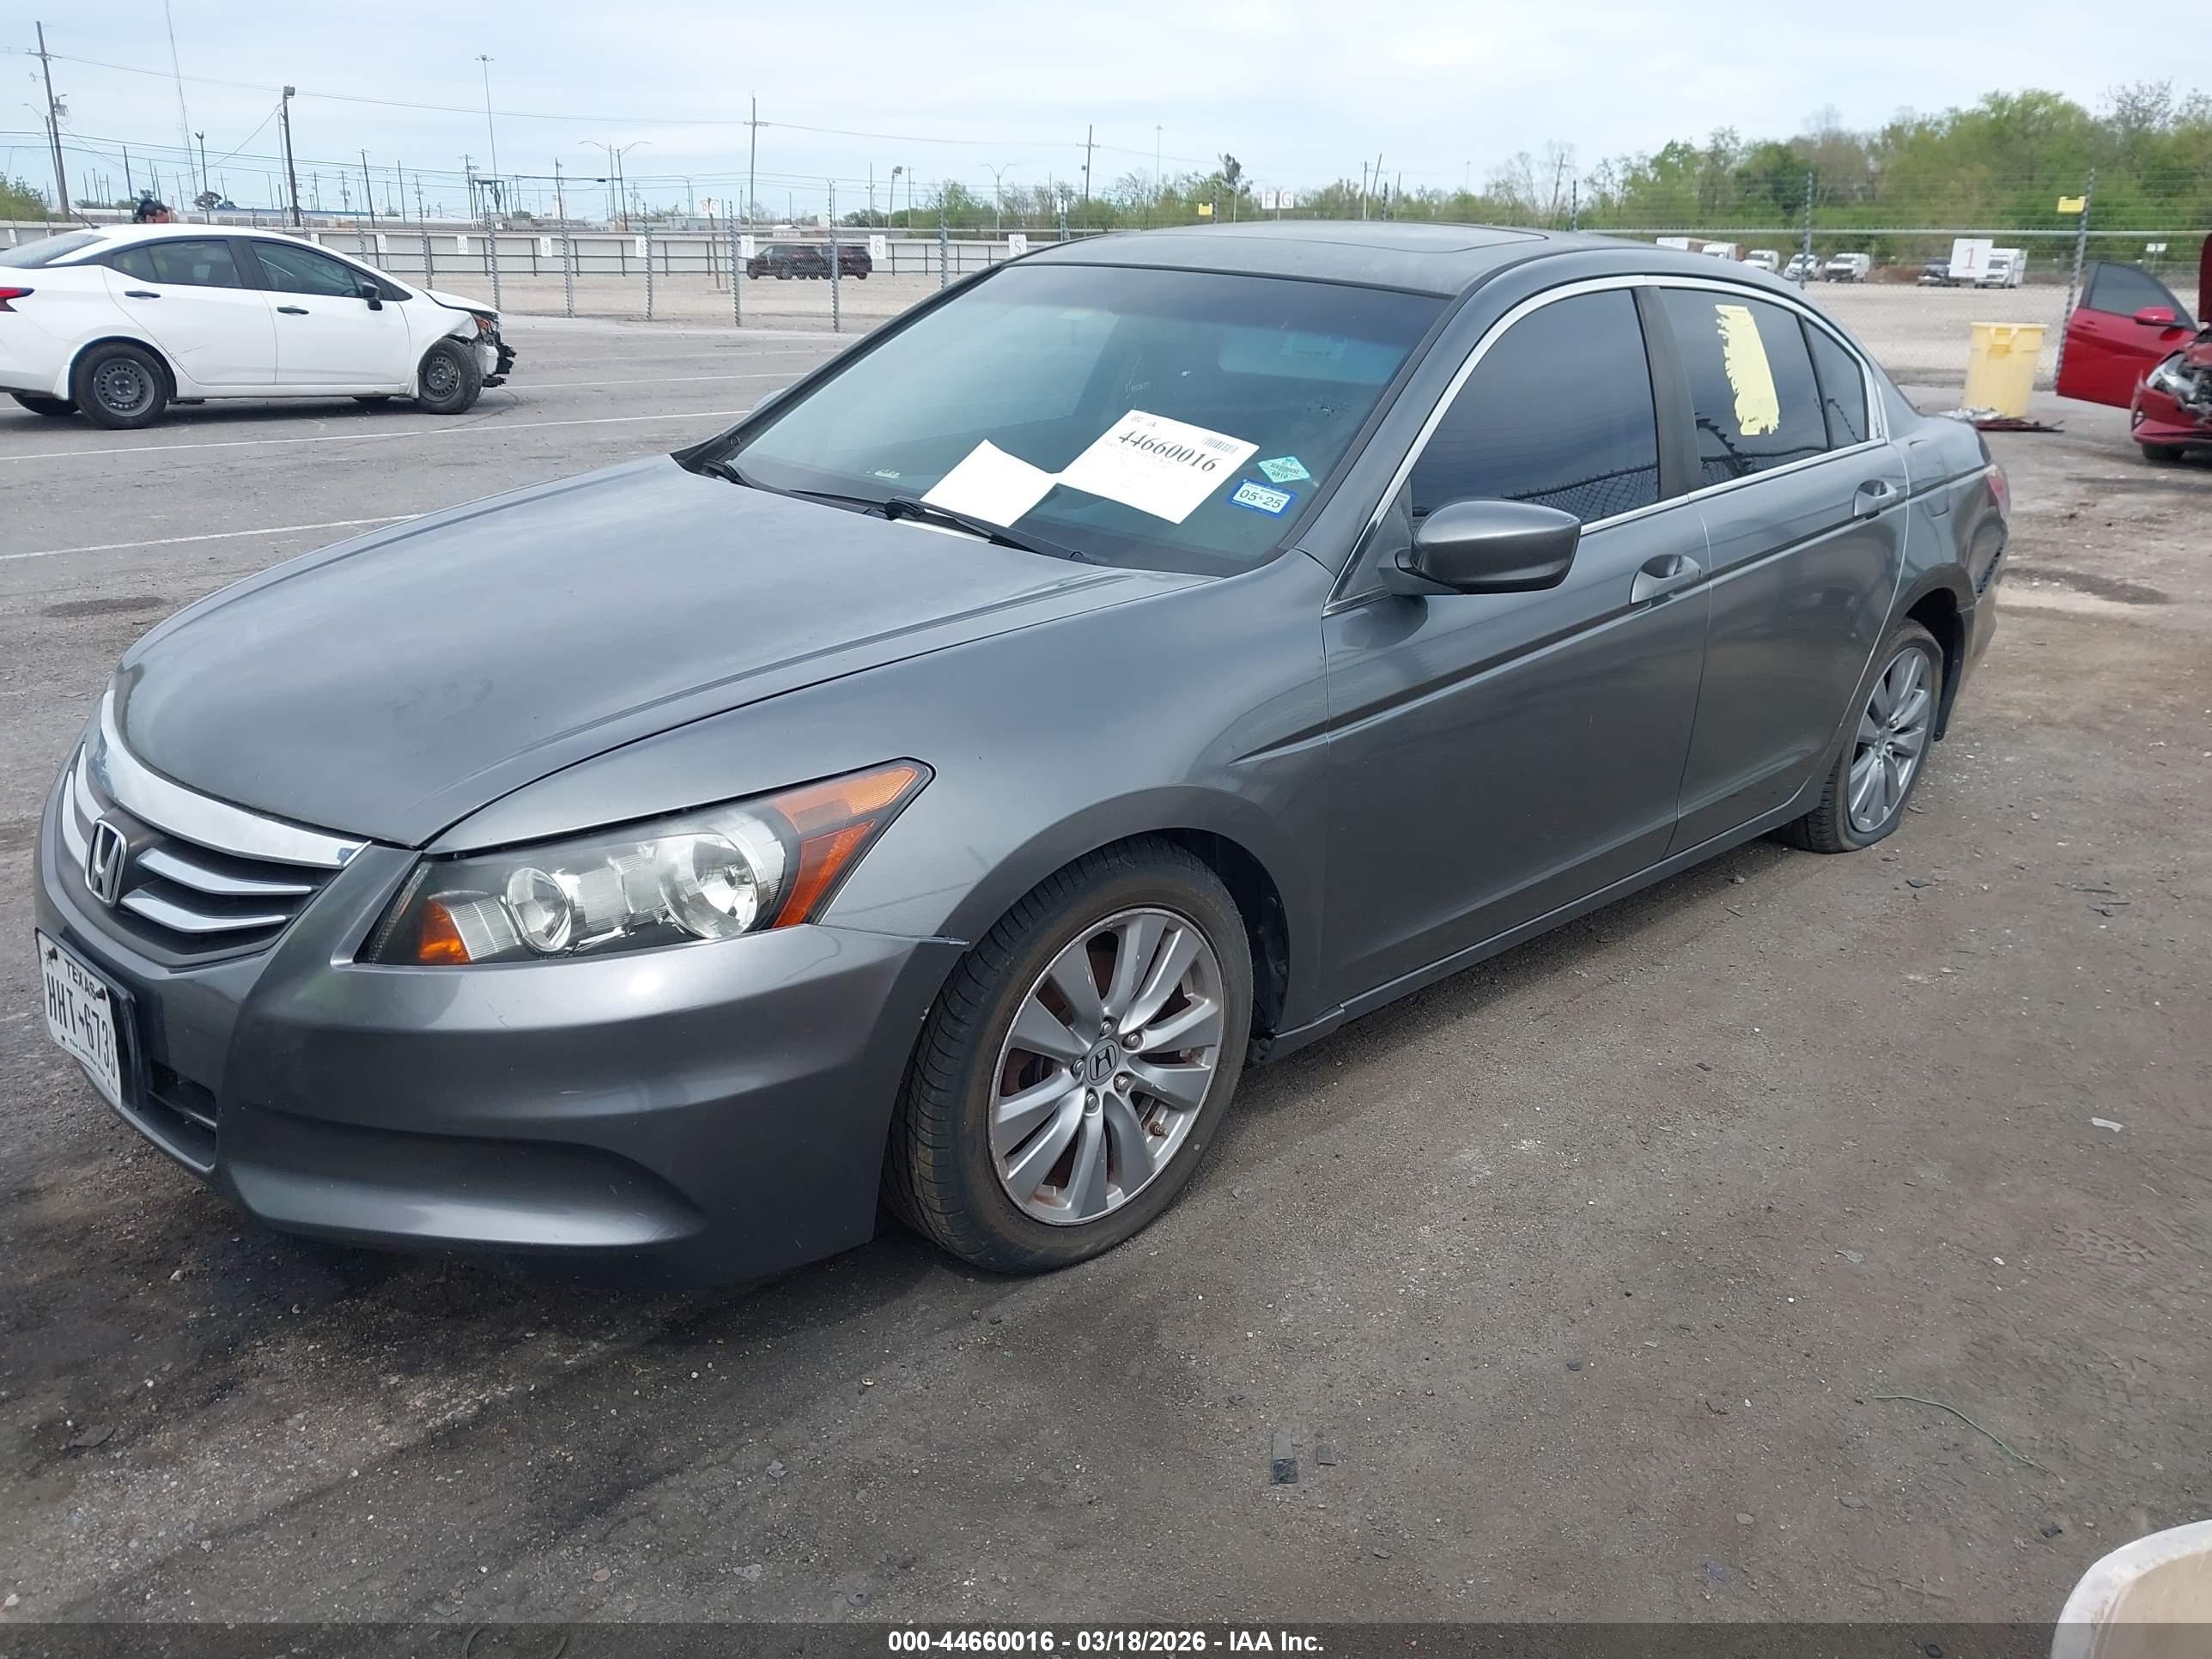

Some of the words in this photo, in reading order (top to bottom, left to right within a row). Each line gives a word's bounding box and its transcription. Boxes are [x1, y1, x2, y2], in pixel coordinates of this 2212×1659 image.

[1282, 191, 1291, 206] G
[459, 238, 467, 251] 10
[543, 240, 550, 252] 9
[638, 240, 645, 252] 8
[744, 240, 751, 253] 7
[874, 240, 882, 255] 6
[1014, 240, 1022, 255] 5
[1963, 246, 1976, 270] 1
[1118, 430, 1223, 472] 44660016
[1239, 489, 1260, 501] 05
[1261, 496, 1284, 508] 25
[64, 958, 97, 1001] TEXAS
